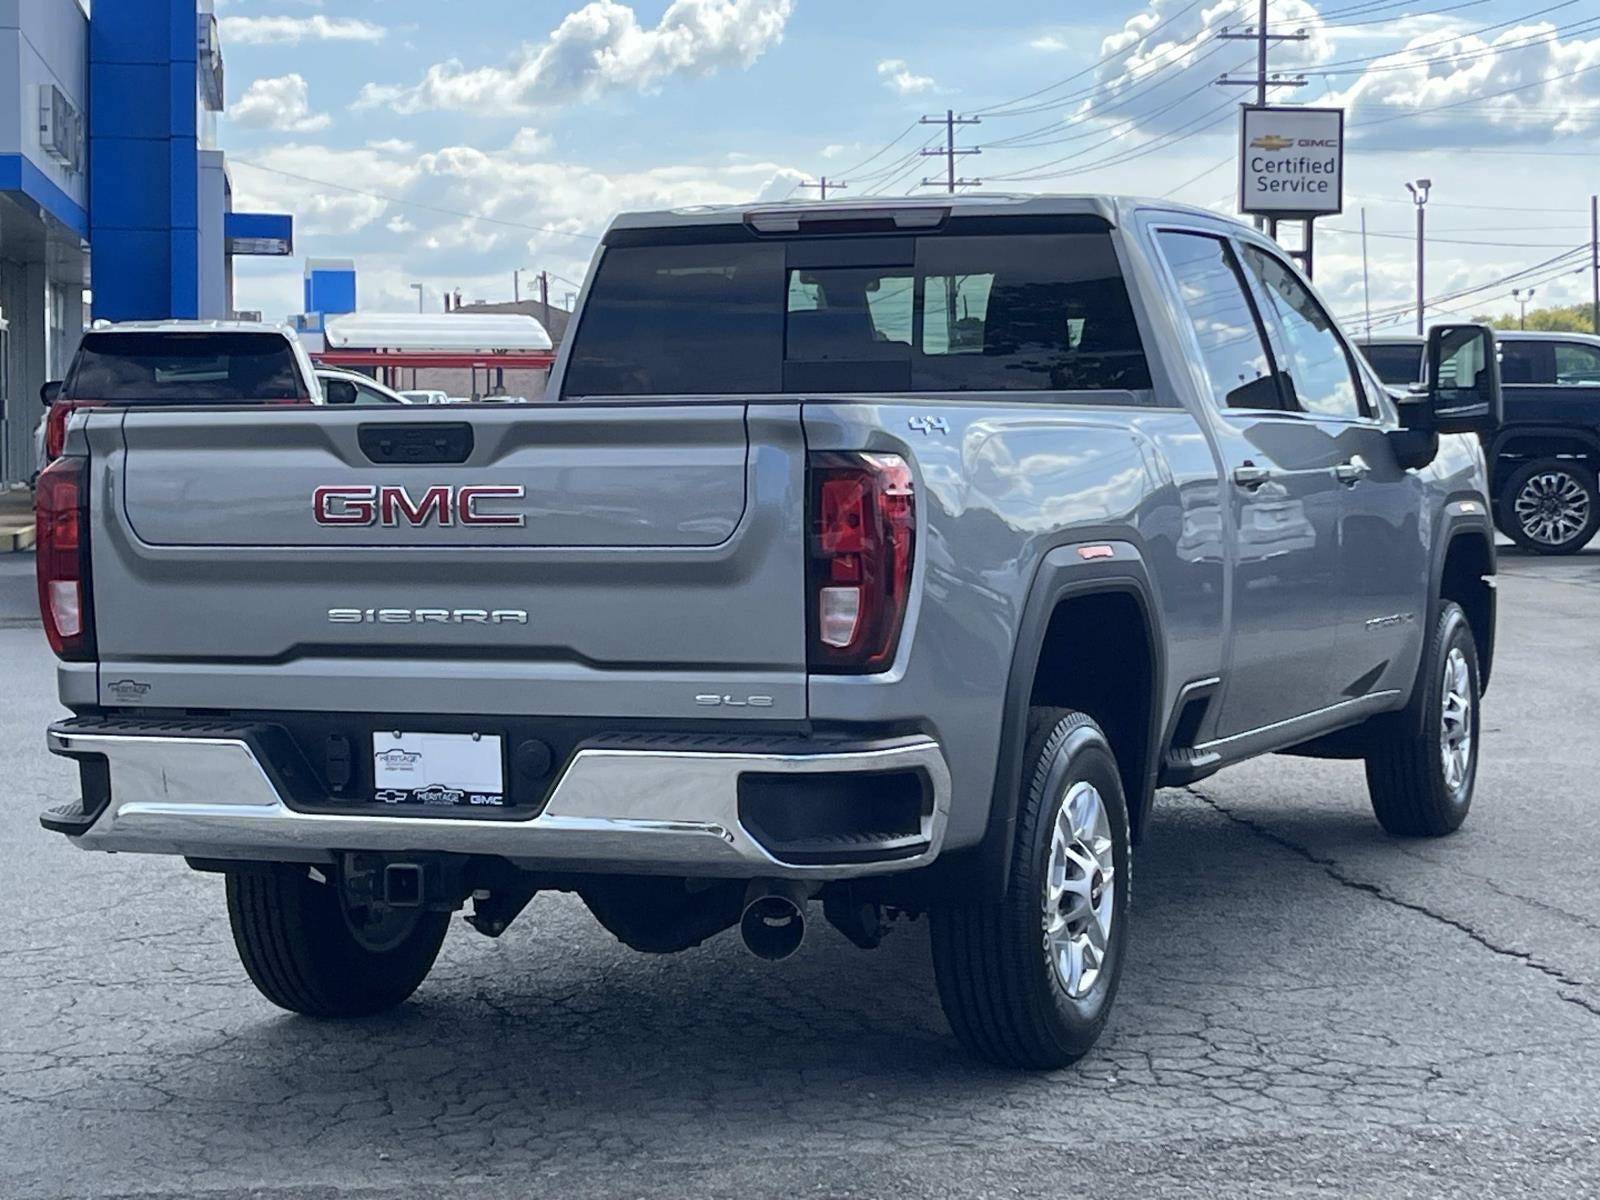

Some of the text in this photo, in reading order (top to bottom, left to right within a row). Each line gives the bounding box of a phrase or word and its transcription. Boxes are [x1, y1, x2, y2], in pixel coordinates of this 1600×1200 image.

[1298, 139, 1337, 147] GMC
[1251, 157, 1334, 174] Certified
[1257, 176, 1328, 193] Service
[312, 485, 526, 528] GMC
[328, 608, 529, 624] SIERRA
[694, 694, 775, 707] SLE
[379, 755, 418, 763] HERITAGE
[416, 792, 460, 803] HERITAGE
[470, 796, 503, 805] GMC
